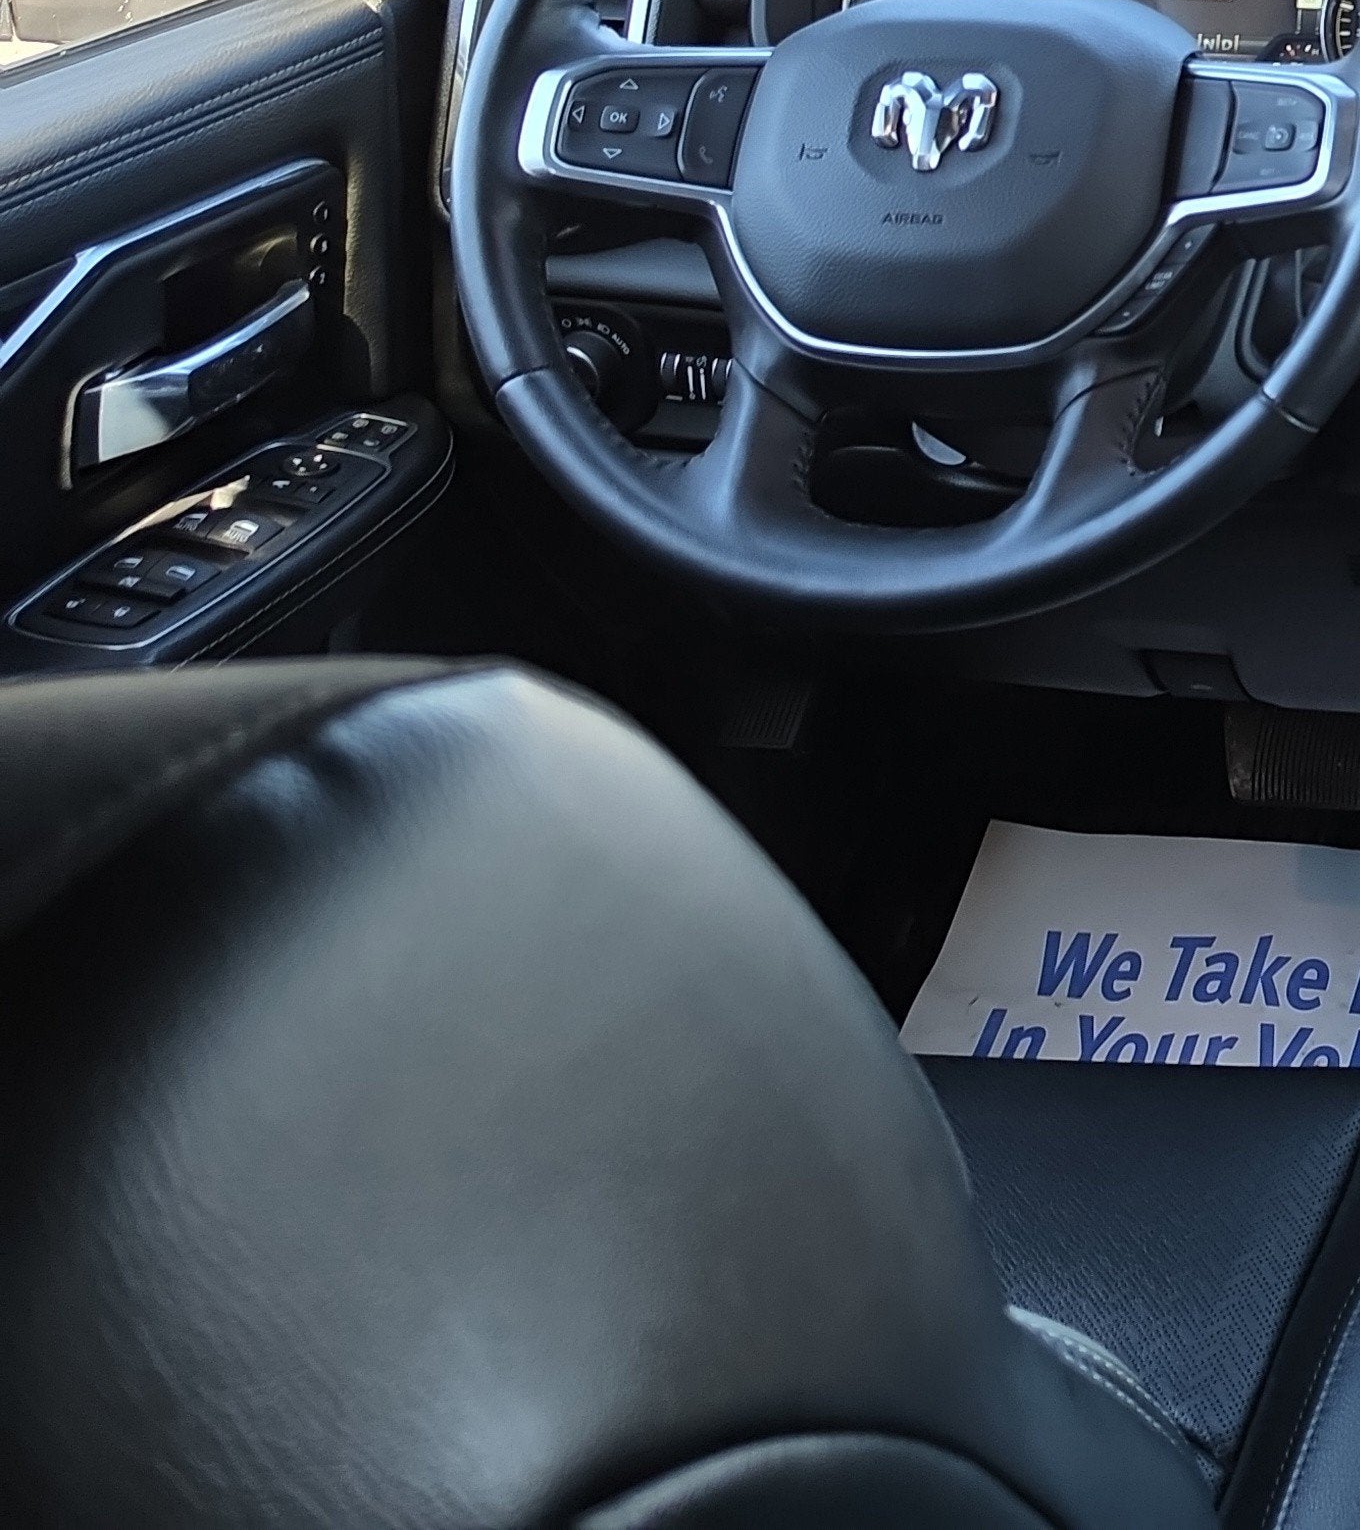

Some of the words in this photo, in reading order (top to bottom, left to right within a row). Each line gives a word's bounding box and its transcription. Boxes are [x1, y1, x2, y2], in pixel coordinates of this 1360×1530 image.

[610, 111, 627, 124] OK
[882, 212, 944, 225] AIRBAG
[611, 332, 631, 355] AUTO
[1037, 930, 1143, 1003] We
[1163, 935, 1330, 1010] Take
[971, 1008, 1047, 1060] In
[1076, 1014, 1239, 1068] Your
